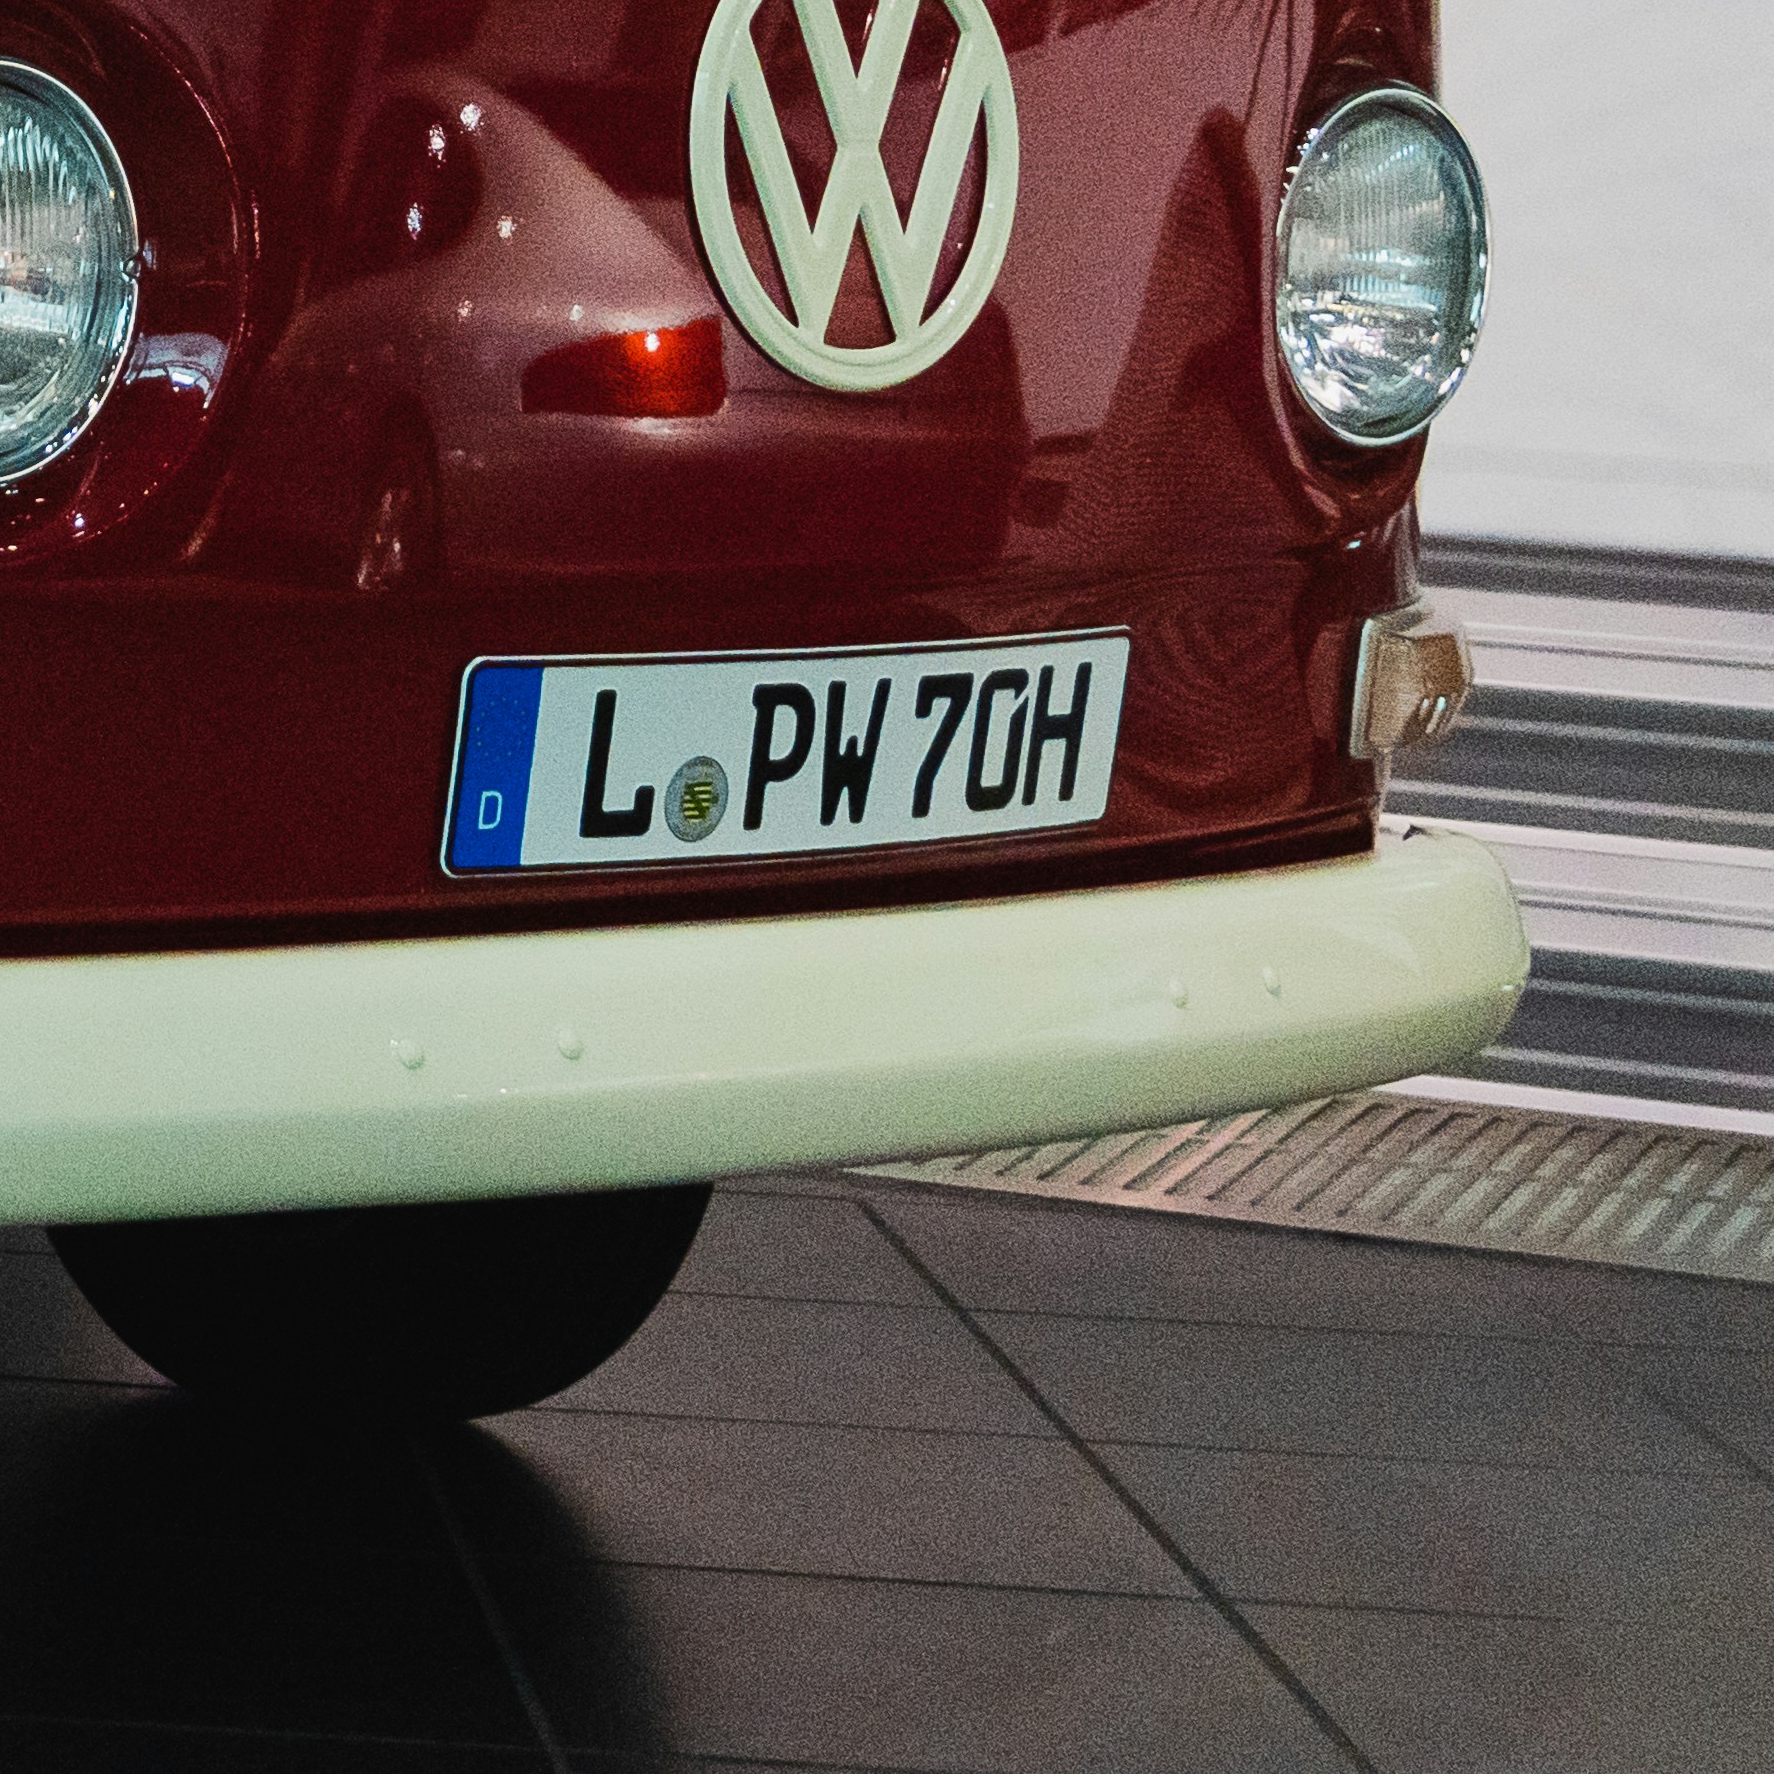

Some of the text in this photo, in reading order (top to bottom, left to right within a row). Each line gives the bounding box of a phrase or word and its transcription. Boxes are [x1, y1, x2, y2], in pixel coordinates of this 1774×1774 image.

[579, 662, 1092, 838] L PW 70H
[477, 790, 503, 830] D
